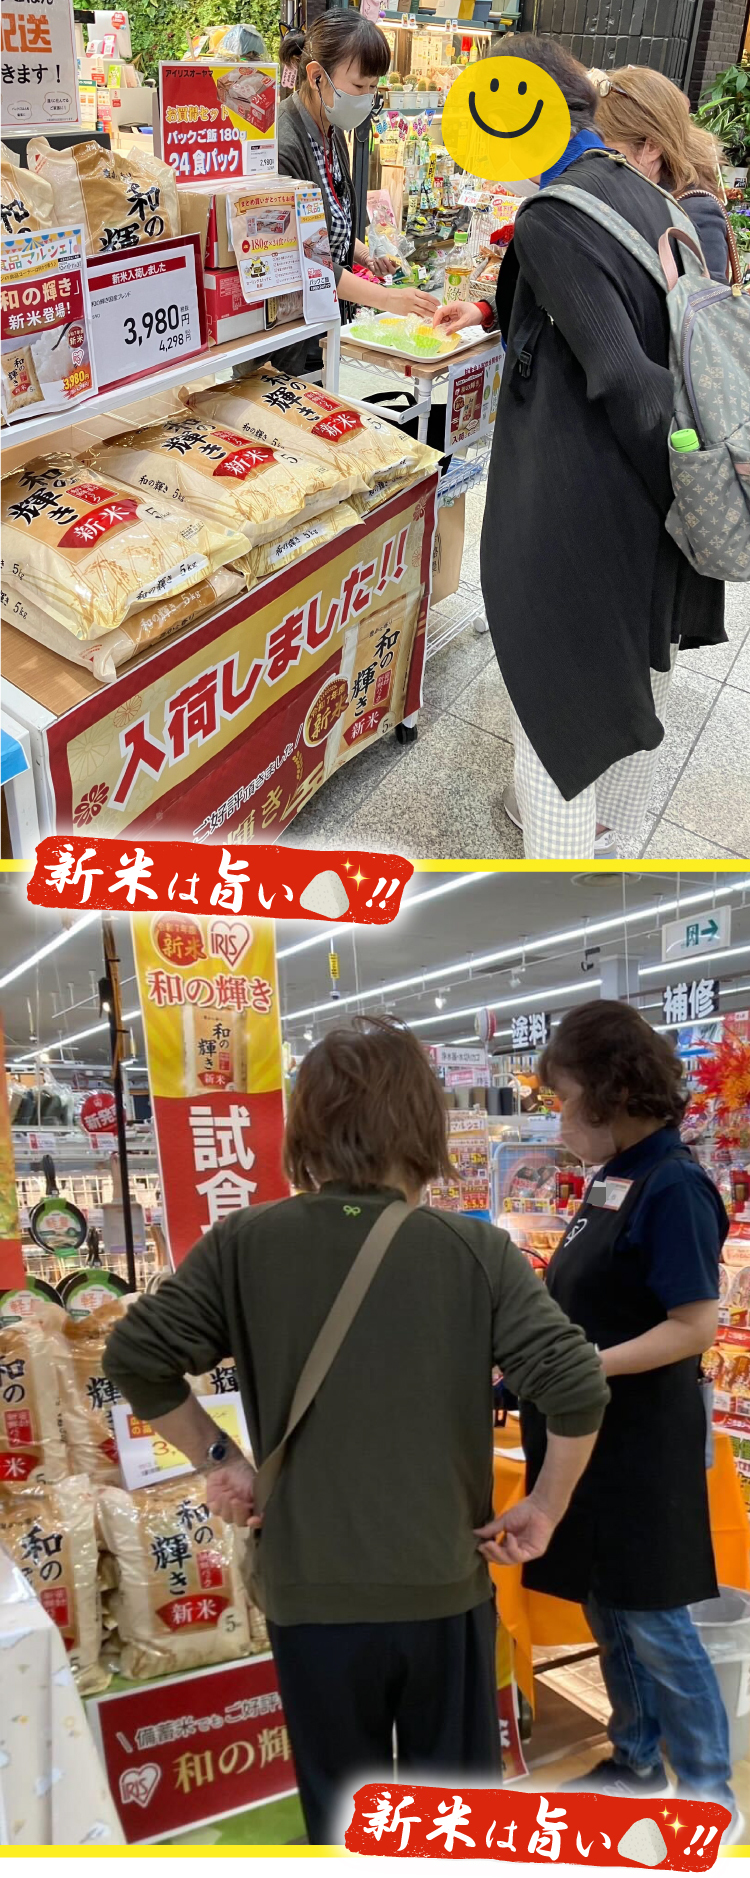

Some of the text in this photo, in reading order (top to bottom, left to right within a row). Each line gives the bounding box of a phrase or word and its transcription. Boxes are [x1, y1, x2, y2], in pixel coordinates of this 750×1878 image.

[165, 69, 213, 78] アイリスオーヤマ
[165, 104, 229, 123] お買得セット
[127, 183, 164, 237] 和の
[306, 203, 321, 214] 食品
[111, 262, 167, 284] 新米入荷しました
[8, 301, 70, 331] 新米登場!
[124, 304, 190, 346] 3,980 円
[69, 335, 84, 345] 新米
[159, 333, 191, 352] 4,298 円
[260, 373, 307, 390] 和の
[262, 387, 323, 422] 輝き
[242, 422, 267, 442] 和の輝き
[321, 411, 358, 436] 新米
[161, 430, 227, 460] 輝き
[224, 449, 268, 475] 新米
[139, 474, 186, 503] 和の輝き 5kg
[8, 488, 78, 525] 輝き
[73, 505, 129, 542] 新米
[302, 527, 319, 541] 5kg
[12, 563, 25, 581] 5kg
[136, 560, 199, 601] 和の輝き 5kg
[13, 601, 28, 620] 5kg
[140, 603, 180, 631] 和の輝き
[374, 628, 400, 669] 和の
[110, 527, 411, 806] 入荷しました!!
[352, 662, 376, 717] 輝き
[311, 691, 349, 740] 新米
[350, 710, 379, 740] 新米
[162, 934, 206, 959] 新米
[149, 971, 273, 1012] 和の輝き
[663, 979, 716, 1022] 補修
[212, 1023, 231, 1050] 和の
[511, 1012, 547, 1048] 塗料
[198, 1039, 217, 1071] 輝き
[204, 1073, 226, 1086] 新米
[178, 1500, 214, 1544] 和の
[21, 1524, 62, 1581] 和の
[151, 1535, 192, 1595] 輝き
[171, 1598, 218, 1624] 新米
[173, 1726, 290, 1793] 和の輝
